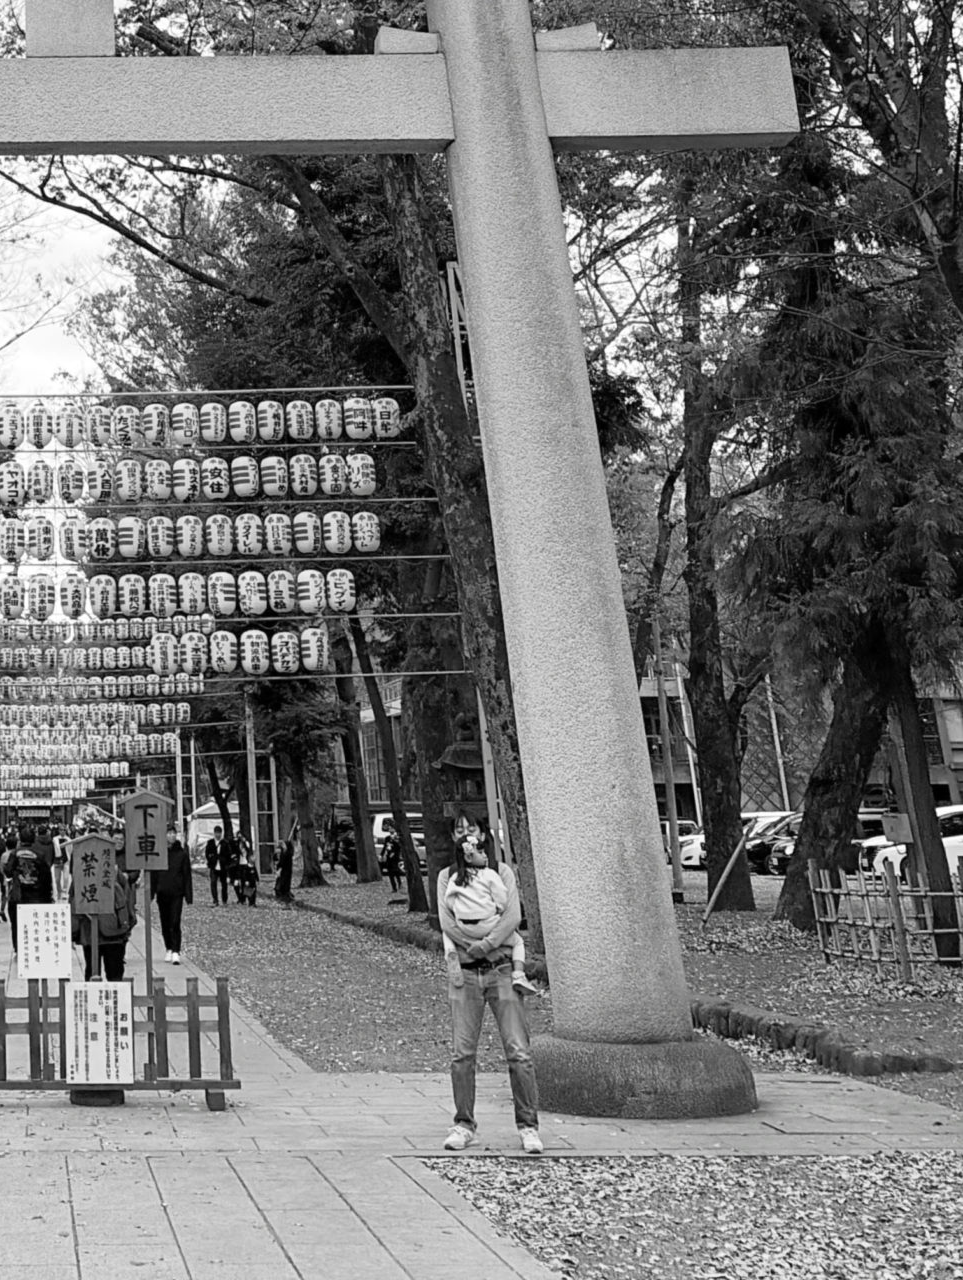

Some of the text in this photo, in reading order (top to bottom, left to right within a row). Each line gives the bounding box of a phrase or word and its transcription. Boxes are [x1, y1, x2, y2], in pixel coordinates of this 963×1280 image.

[208, 467, 224, 494] 安住
[134, 804, 160, 862] 下車
[79, 852, 99, 904] 禁煙
[120, 1013, 129, 1050] お願い
